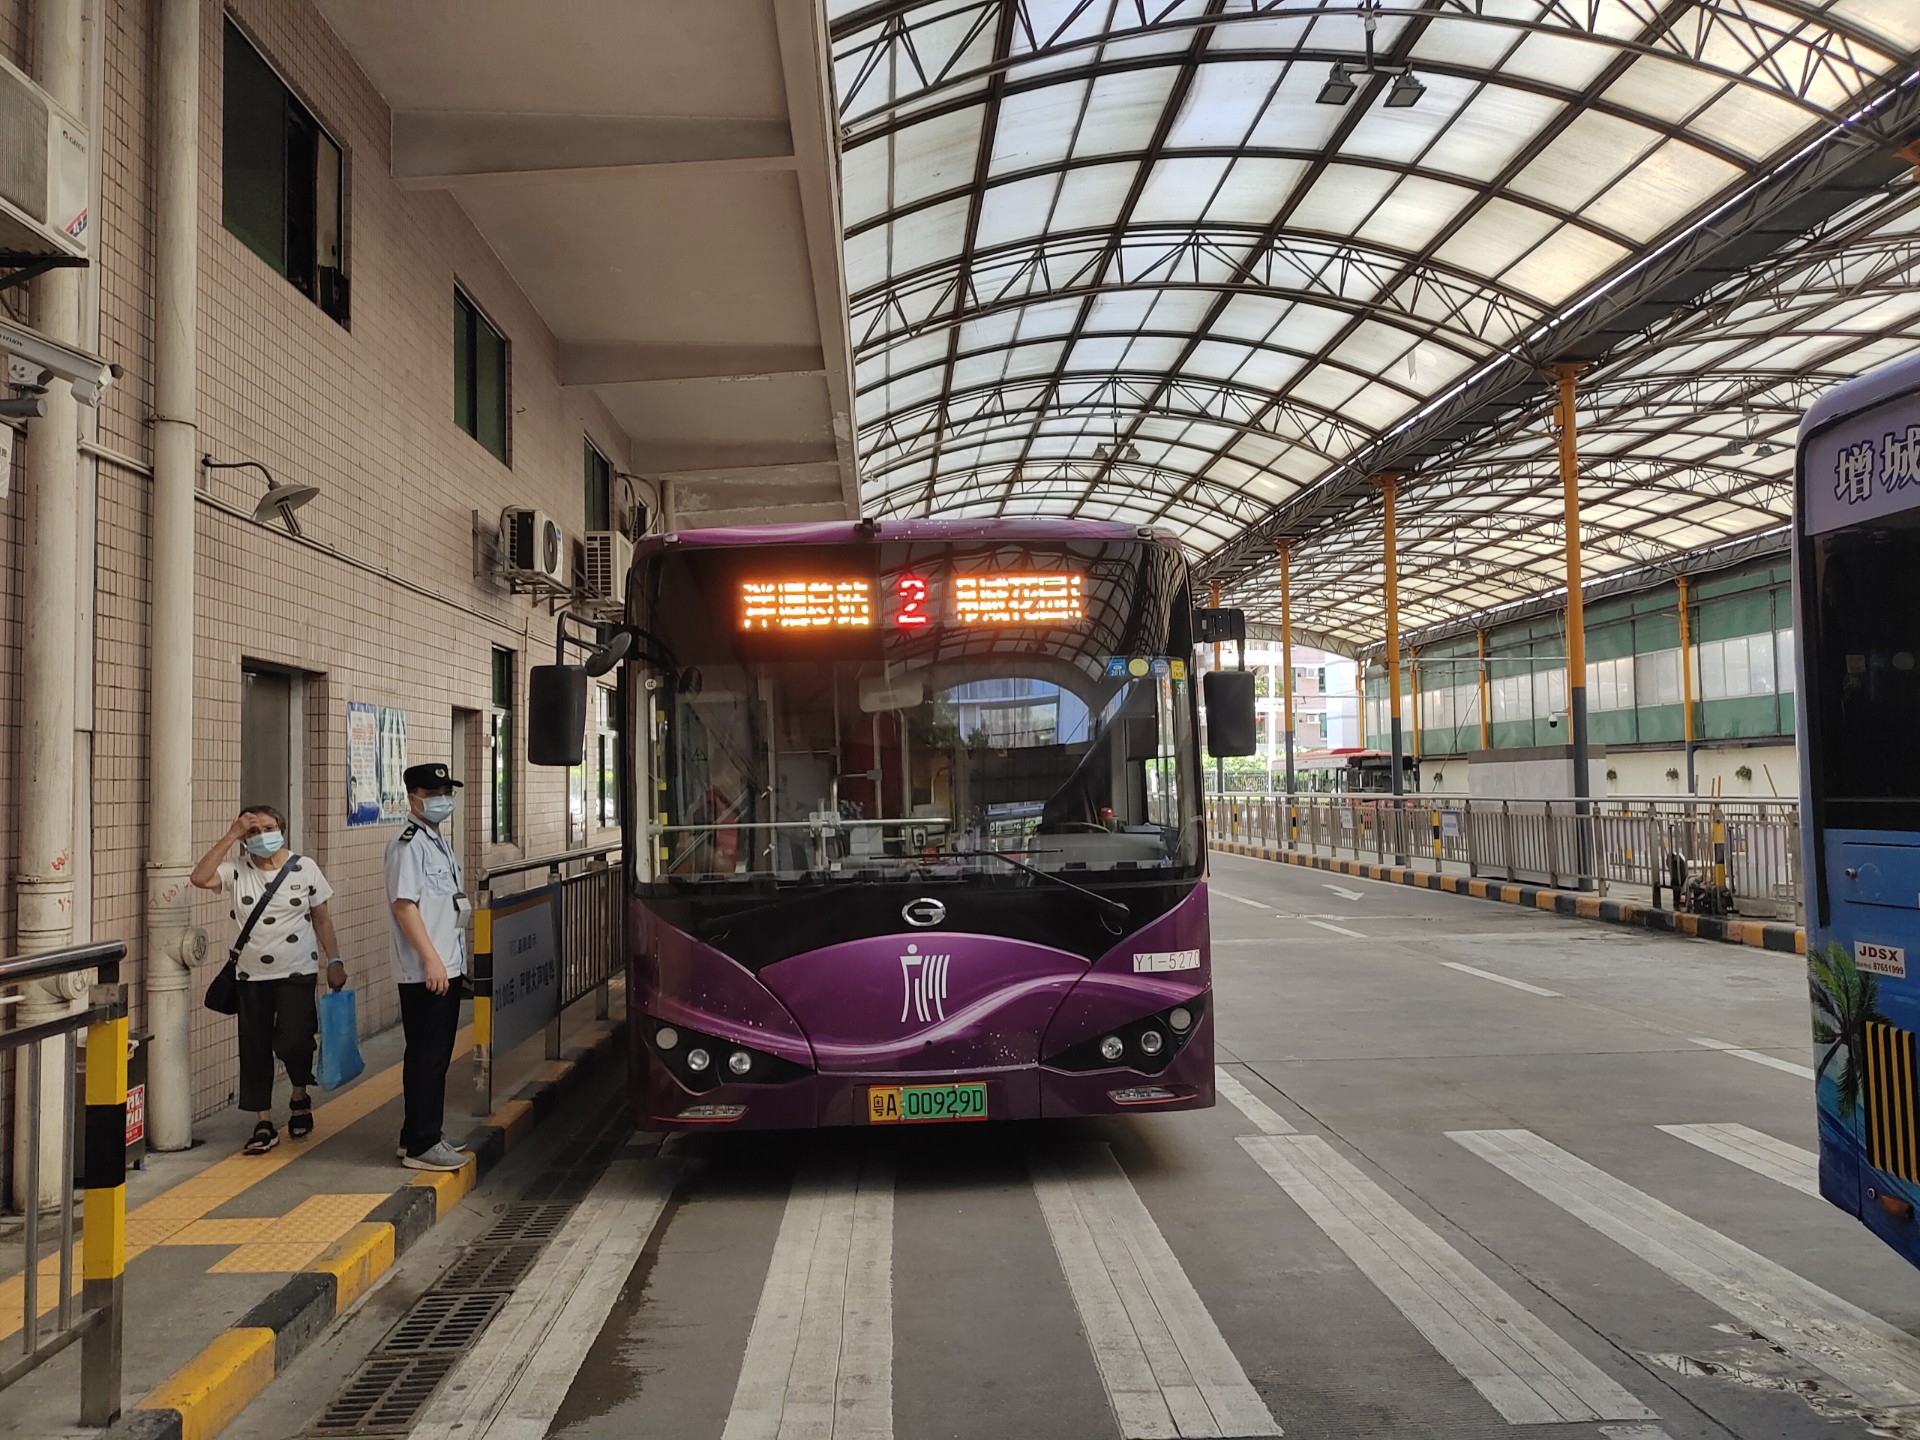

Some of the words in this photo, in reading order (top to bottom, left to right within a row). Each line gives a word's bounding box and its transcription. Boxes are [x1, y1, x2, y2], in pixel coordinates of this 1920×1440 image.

[1834, 424, 1920, 505] 增城
[897, 578, 927, 624] 2
[1135, 950, 1200, 971] Y1-5270
[1859, 945, 1899, 962] JDSX
